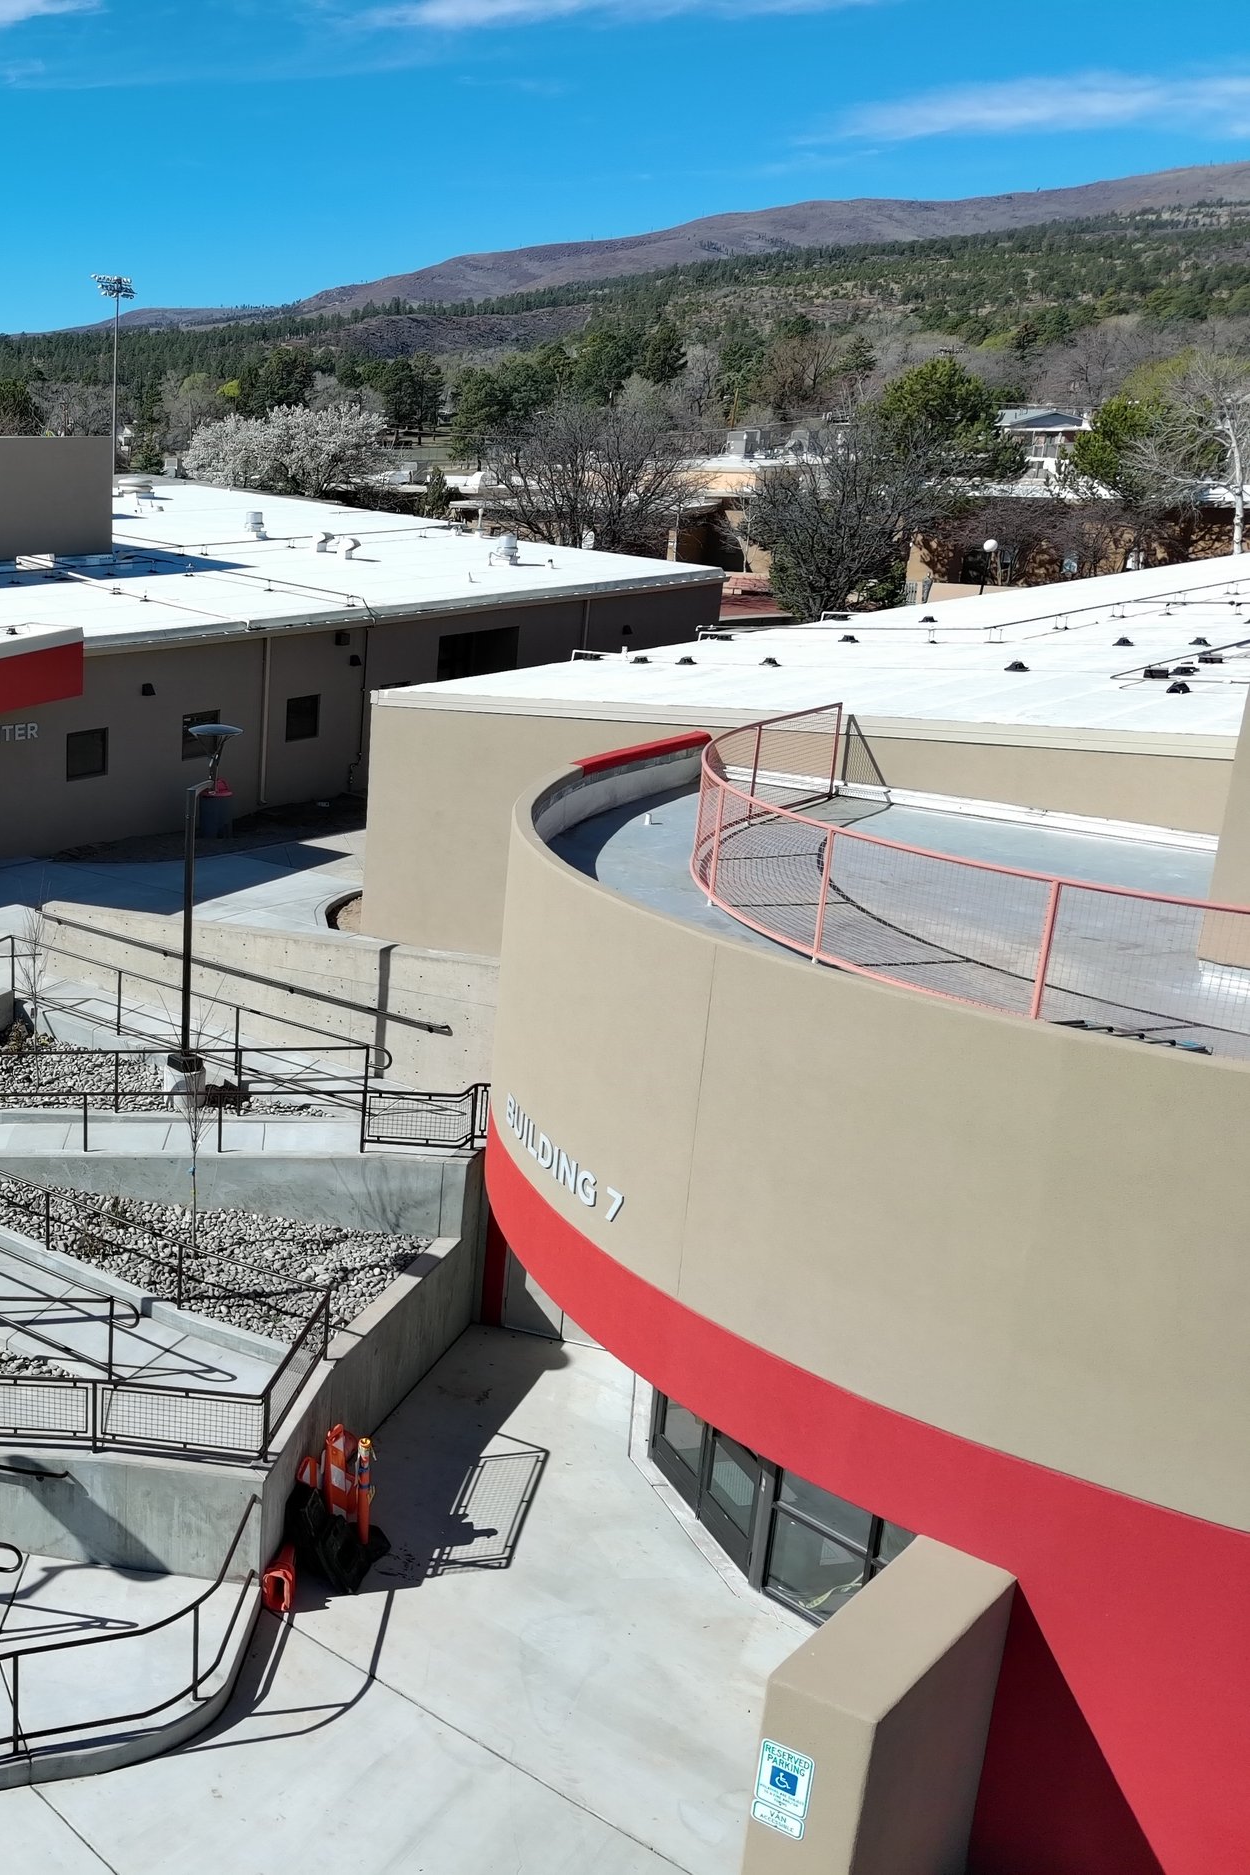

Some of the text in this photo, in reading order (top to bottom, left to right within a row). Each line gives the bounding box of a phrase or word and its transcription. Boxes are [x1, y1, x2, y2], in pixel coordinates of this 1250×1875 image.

[506, 1092, 625, 1222] BUILDING 7
[765, 1743, 810, 1770] RESERVED
[767, 1753, 806, 1777] PARKING
[769, 1810, 787, 1824] VAN
